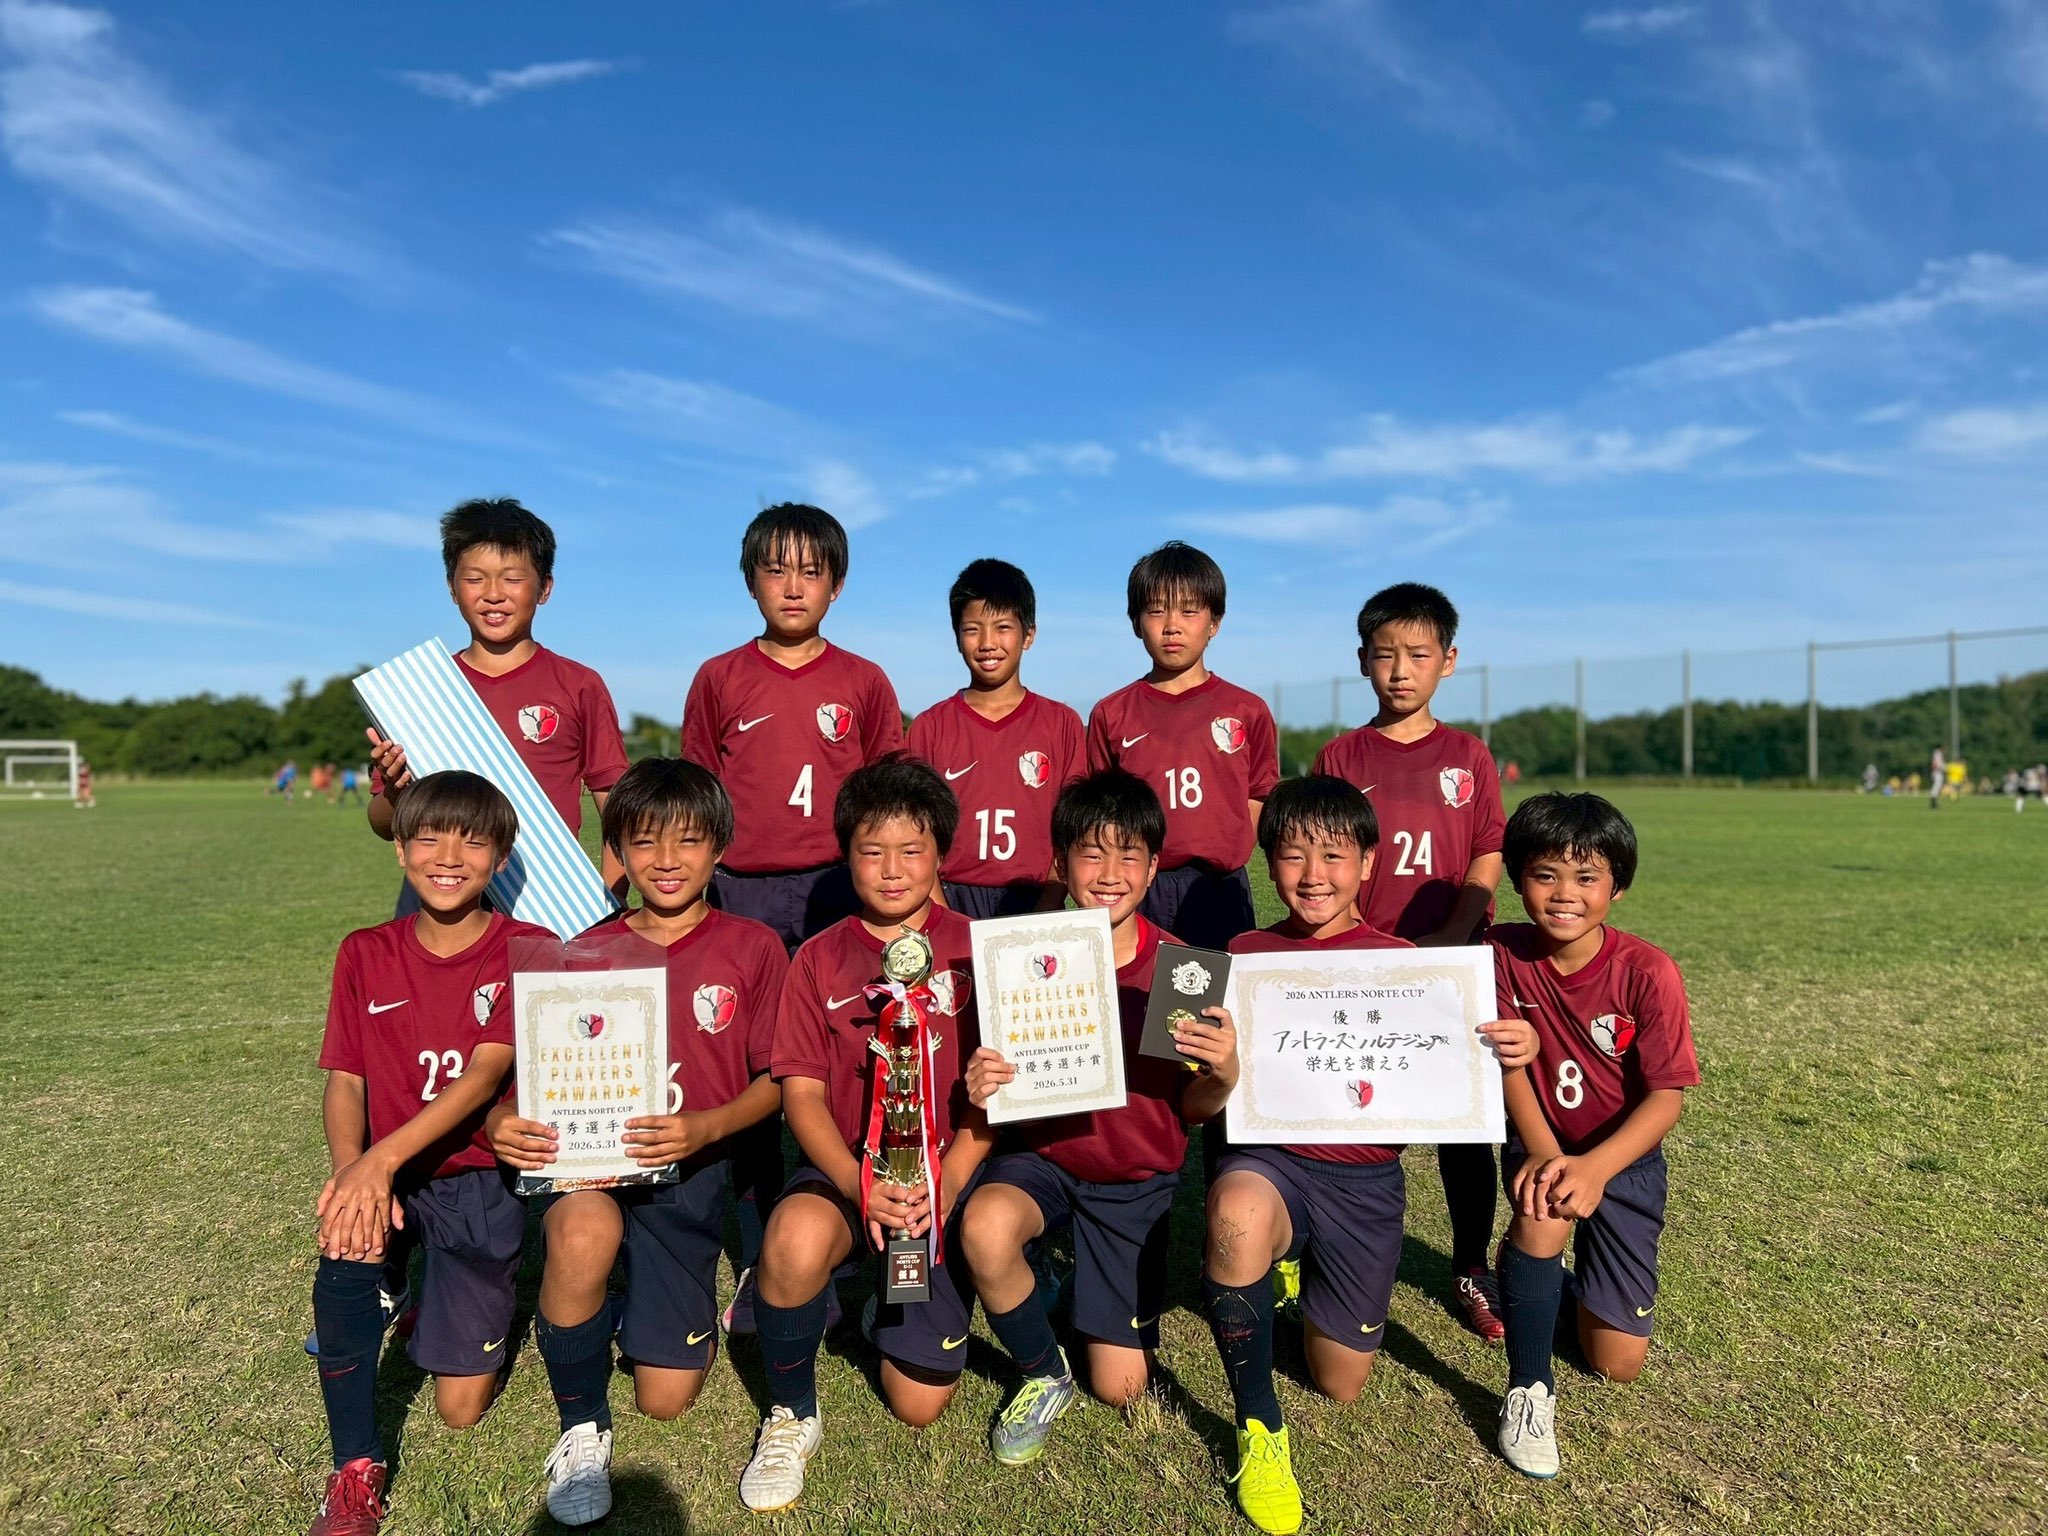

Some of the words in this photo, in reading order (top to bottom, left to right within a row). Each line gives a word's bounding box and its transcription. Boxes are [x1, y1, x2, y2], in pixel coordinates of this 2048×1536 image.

[788, 765, 813, 817] 4
[1165, 766, 1203, 810] 18
[975, 808, 1017, 861] 15
[1393, 830, 1432, 876] 24
[1001, 981, 1098, 1006] EXCELLENT
[1285, 991, 1306, 1000] 2026
[1308, 990, 1359, 999] ANTLERS
[1361, 989, 1400, 999] NORTE
[1402, 988, 1425, 998] CUP
[1012, 1003, 1089, 1024] PLAYERS
[1022, 1022, 1083, 1042] AWARD
[540, 1043, 645, 1063] EXCELLENT
[1014, 1047, 1048, 1058] ANTLERS
[1048, 1045, 1074, 1054] NORTE
[1075, 1043, 1090, 1051] CUP
[418, 1049, 463, 1101] 23
[551, 1063, 634, 1082] PLAYERS
[559, 1084, 625, 1102] AWARD
[1033, 1076, 1078, 1090] 2026.5.31
[1555, 1059, 1584, 1110] 8
[551, 1108, 587, 1116] ANTLERS
[588, 1107, 616, 1115] NORTE
[617, 1105, 634, 1113] CUP
[547, 1119, 637, 1135] 優秀選手
[568, 1140, 617, 1151] 2026.5.31
